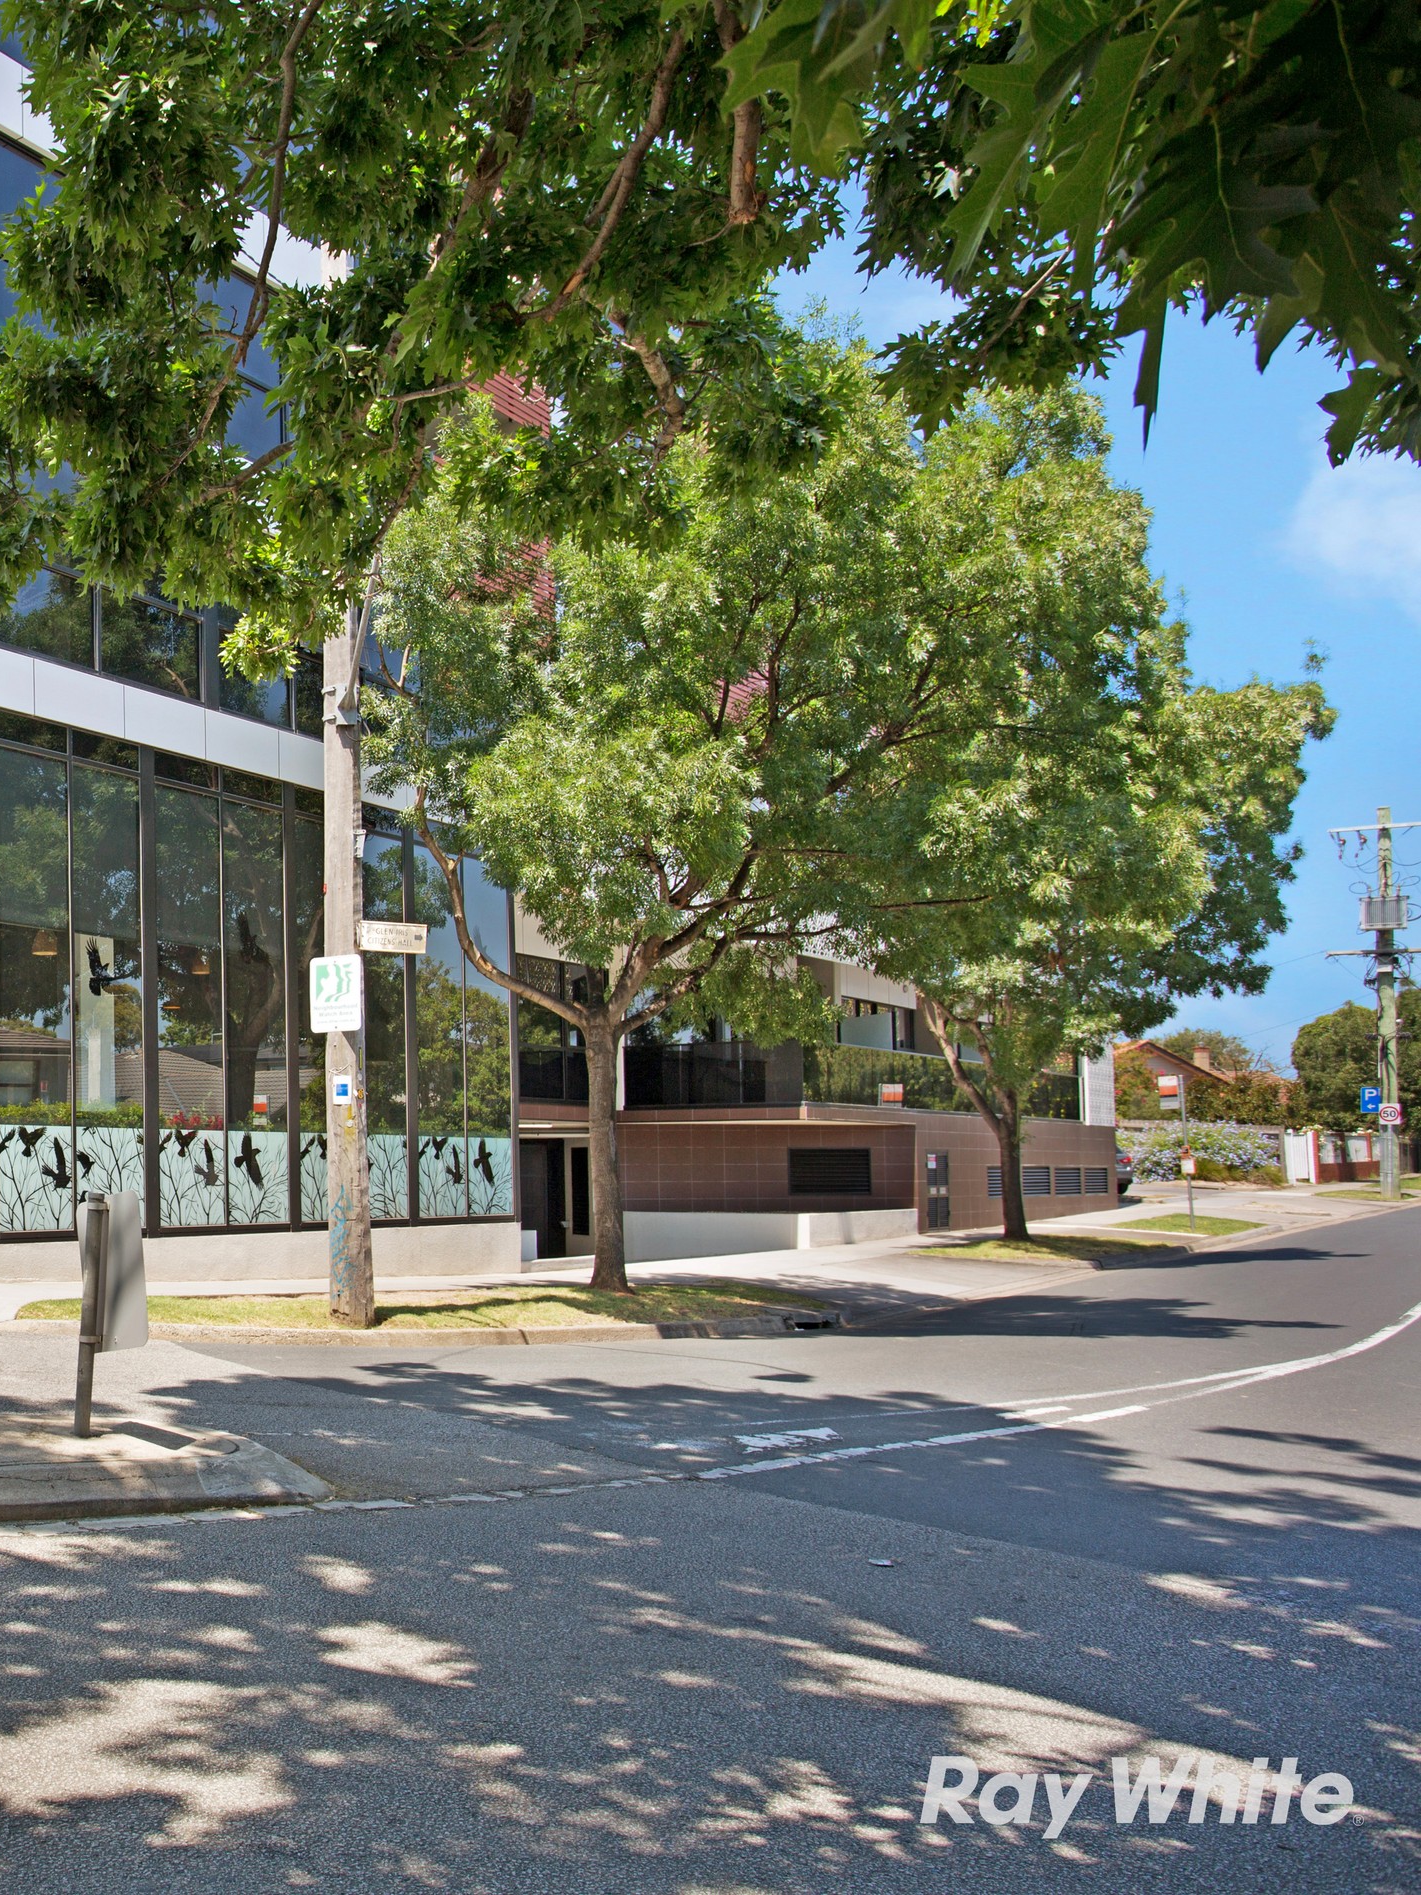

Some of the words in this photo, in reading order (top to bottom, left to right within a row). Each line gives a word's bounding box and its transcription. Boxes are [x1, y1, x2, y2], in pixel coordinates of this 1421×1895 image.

[375, 927, 394, 935] GLEN
[395, 929, 409, 937] IRIS
[398, 939, 413, 947] HALL
[1365, 1089, 1377, 1101] P
[1382, 1110, 1397, 1118] 50
